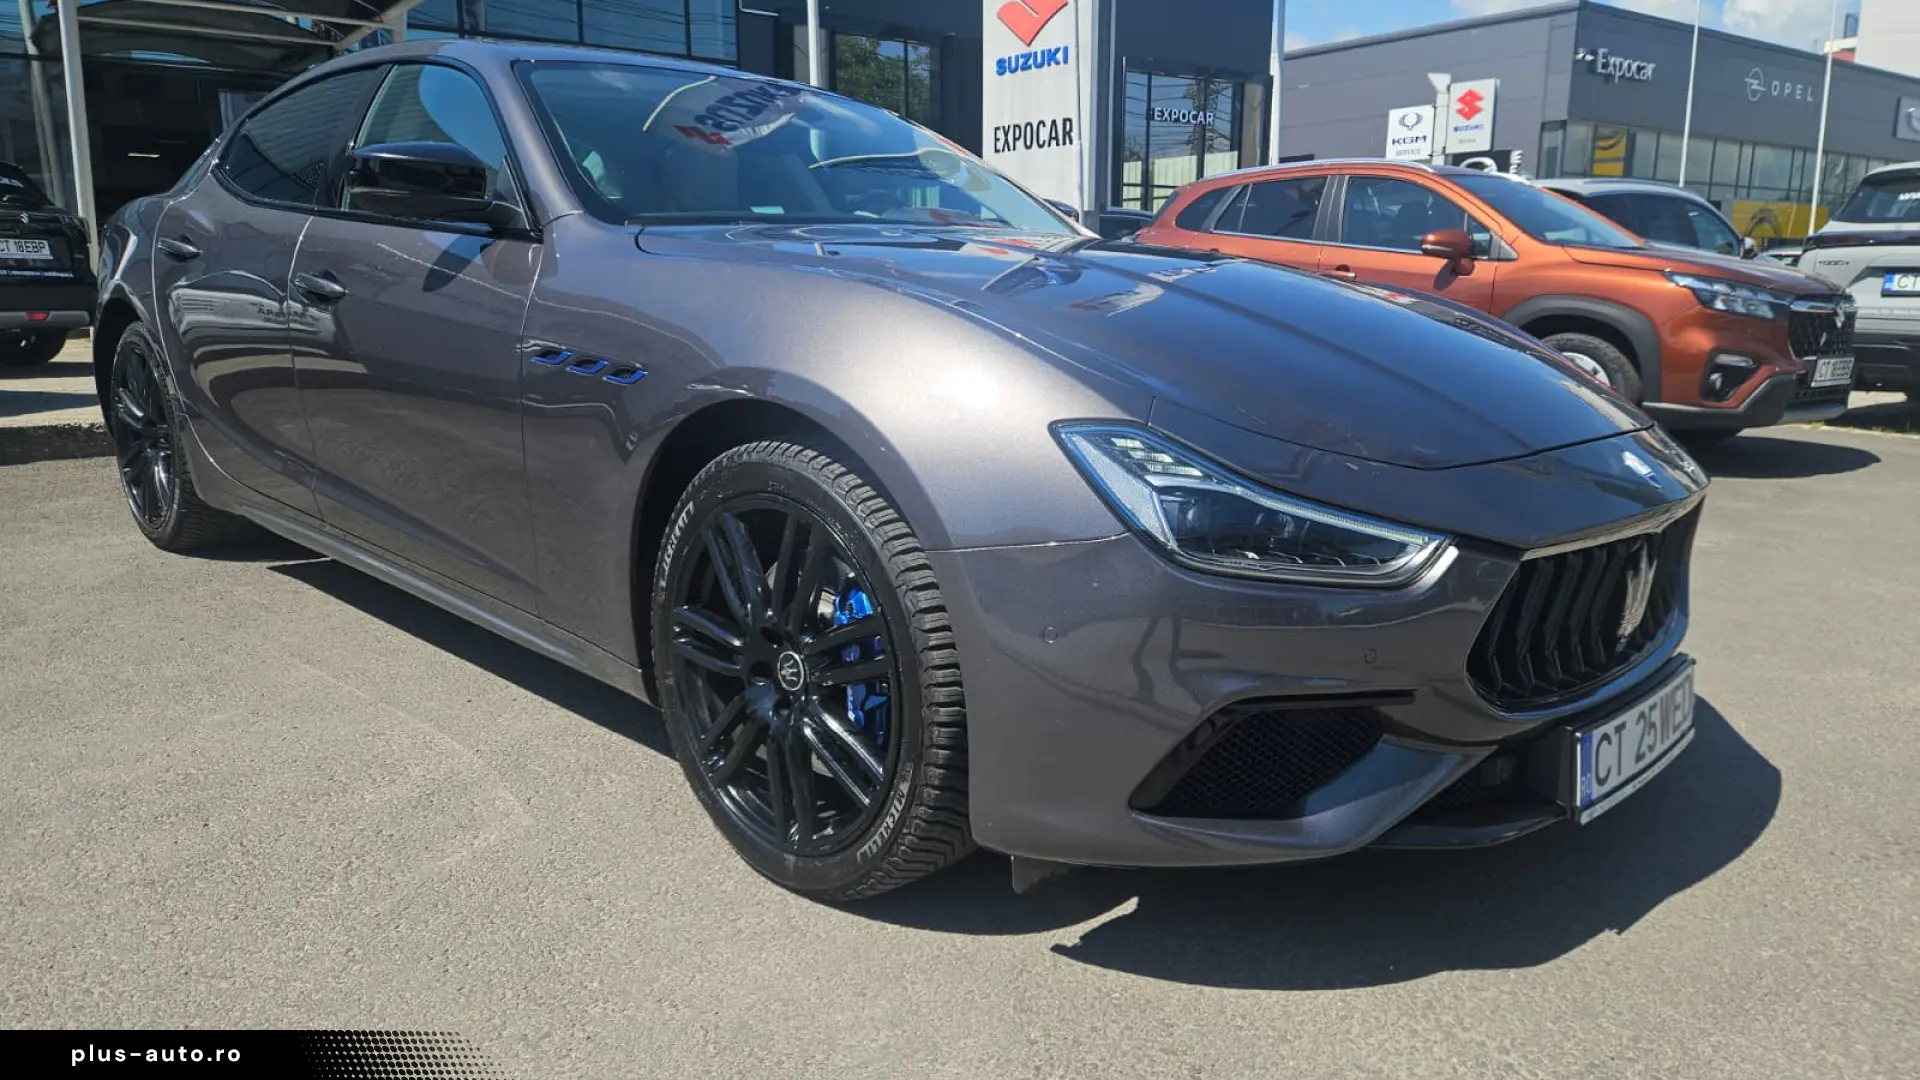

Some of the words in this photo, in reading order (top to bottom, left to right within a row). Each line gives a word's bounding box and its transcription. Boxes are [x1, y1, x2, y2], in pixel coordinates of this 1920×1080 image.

[995, 45, 1069, 76] SUZUKI
[1597, 48, 1656, 84] Expocar
[1770, 80, 1814, 102] OPEL
[1153, 107, 1214, 126] EXPOCAR
[993, 117, 1074, 154] EXPOCAR
[1391, 135, 1428, 146] KGM
[1595, 721, 1627, 787] CT
